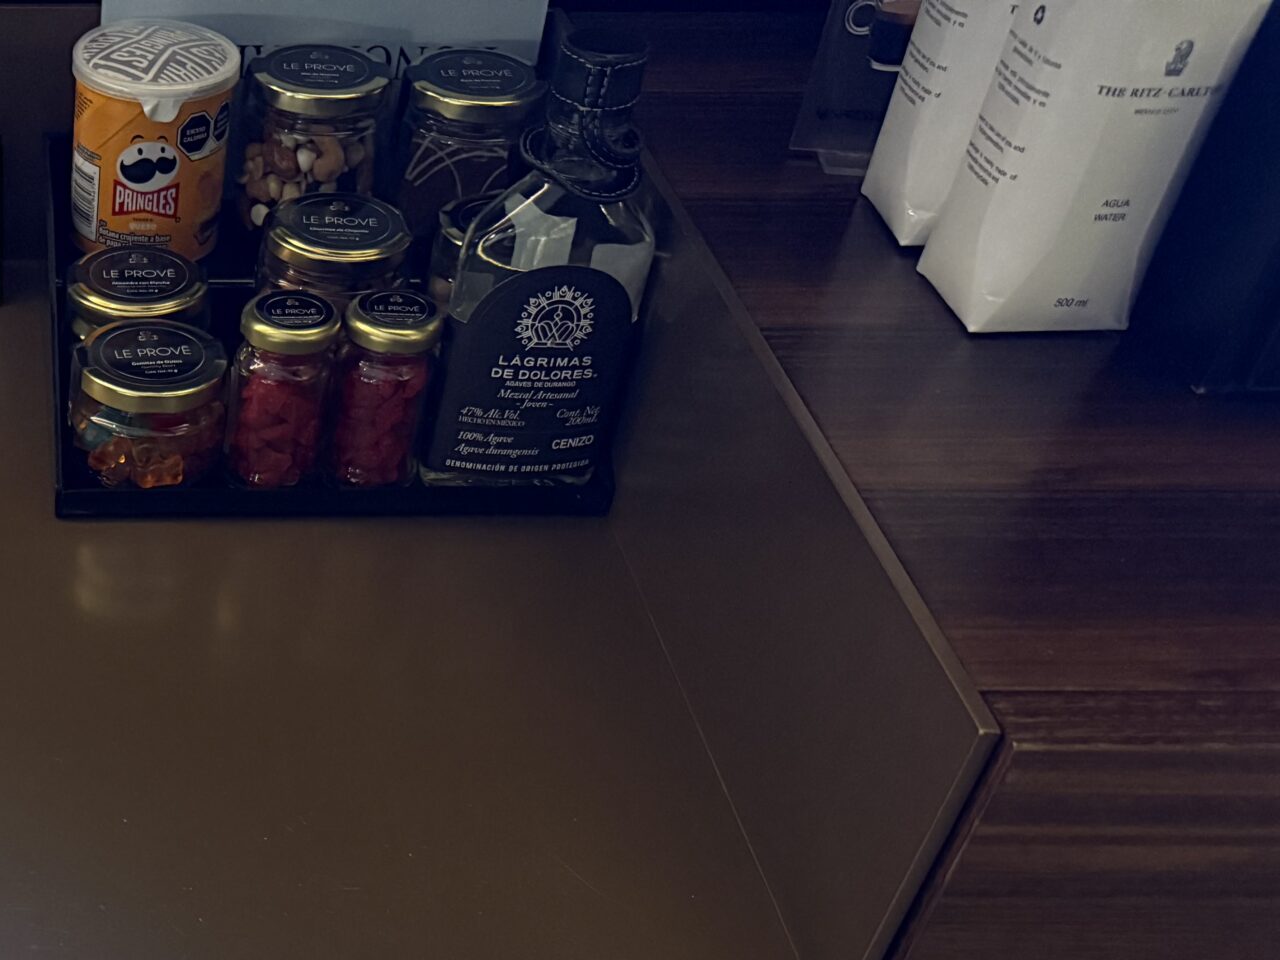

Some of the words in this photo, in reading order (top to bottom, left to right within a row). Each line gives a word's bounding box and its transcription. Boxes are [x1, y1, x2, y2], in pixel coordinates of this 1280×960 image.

[283, 62, 300, 71] LE
[304, 62, 355, 72] PROVE
[440, 69, 455, 77] LE
[462, 69, 513, 78] PROVE
[1097, 84, 1127, 97] THE
[114, 185, 177, 216] PRINGLES
[1101, 199, 1131, 208] AGUA
[302, 215, 319, 224] LE
[325, 216, 379, 227] PROVE
[1093, 213, 1126, 222] WATER
[102, 269, 119, 278] LE
[124, 268, 176, 278] PROVE
[1054, 297, 1075, 307] 500
[1075, 297, 1088, 307] ml
[114, 349, 133, 359] LE
[137, 345, 192, 357] PROVE
[498, 354, 592, 367] LÁGRIMAS
[490, 367, 514, 379] DE
[518, 368, 593, 380] DOLORES
[497, 388, 533, 399] Mezcal
[533, 389, 579, 399] Artesanal
[460, 406, 483, 416] 47%
[483, 407, 503, 418] Alc.
[503, 409, 520, 419] Vol.
[556, 408, 580, 418] Cont.
[459, 415, 483, 424] HECHO
[457, 431, 484, 441] 100%
[484, 433, 514, 445] Agave
[552, 435, 595, 450] CENIZO
[454, 443, 484, 455] Agave
[485, 446, 540, 458] durangensis
[445, 458, 506, 472] DENOMINACIÓN
[508, 464, 518, 472] DE
[521, 464, 549, 472] ORIGEN
